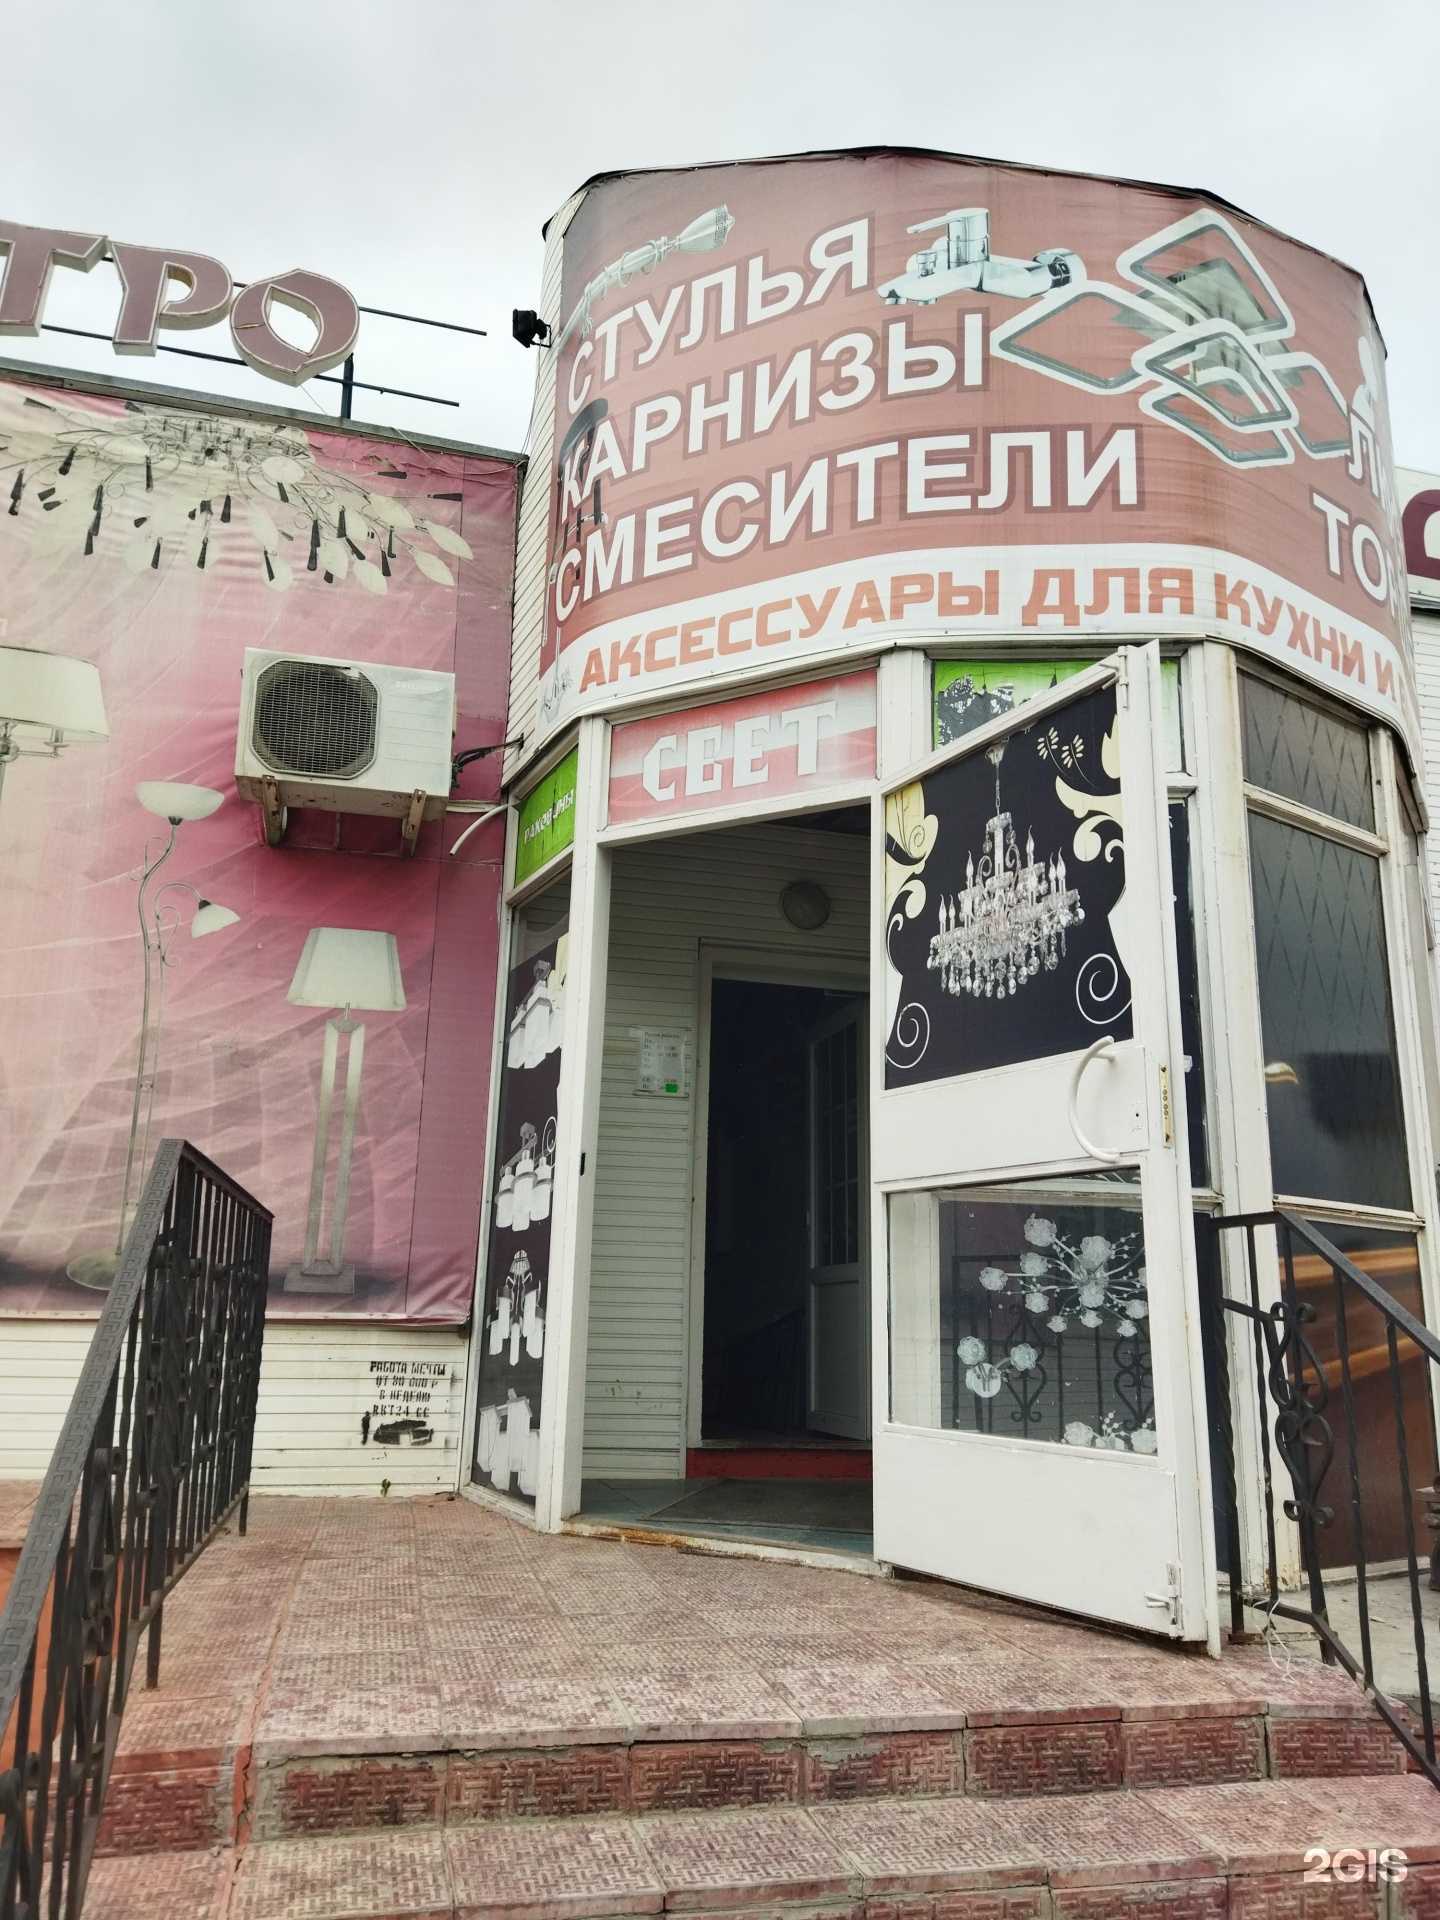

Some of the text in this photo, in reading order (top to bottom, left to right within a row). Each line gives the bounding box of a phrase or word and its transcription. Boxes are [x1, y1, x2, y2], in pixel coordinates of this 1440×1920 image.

[568, 218, 869, 414] СТУЛЬЯ
[561, 313, 984, 524] КАРНИЗЫ
[555, 429, 1138, 622] СМЕСИТЕЛИ
[579, 569, 1000, 694] АКСЕССУАРЫ
[1021, 567, 1194, 627] ДЛЯ
[1213, 572, 1366, 685] КУХНИ
[641, 700, 839, 802] СВЕТ
[369, 1360, 446, 1376] РАБОТА МЕЧТЫ
